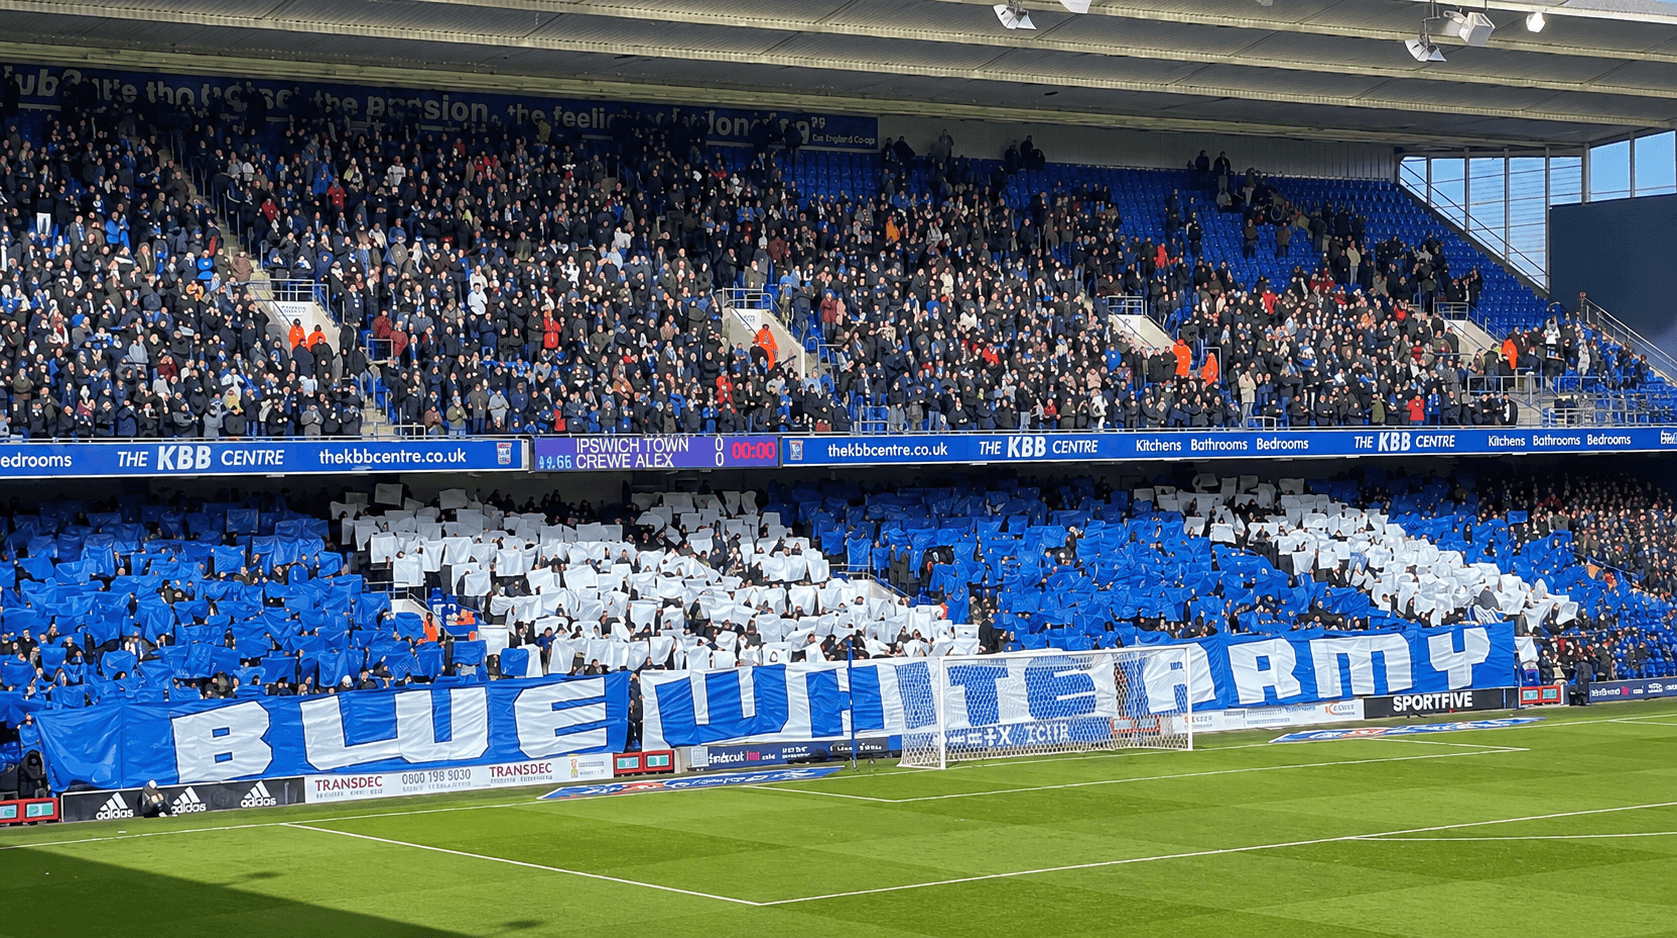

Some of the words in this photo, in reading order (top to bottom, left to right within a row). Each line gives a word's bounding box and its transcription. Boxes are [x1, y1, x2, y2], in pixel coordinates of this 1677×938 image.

[576, 438, 640, 453] IPSWICH
[643, 438, 690, 453] TOWN
[714, 437, 724, 452] 0
[979, 440, 1002, 455] THE
[1006, 435, 1047, 458] KBB
[1052, 439, 1099, 454] CENTRE
[1136, 438, 1182, 452] Kitchens
[1190, 437, 1248, 451] Bathrooms
[1256, 436, 1309, 450] Bedrooms
[1354, 436, 1374, 449] THE
[1378, 432, 1412, 452] KBB
[1415, 434, 1456, 448] CENTRE
[1488, 435, 1526, 447] Kitchens
[1532, 434, 1581, 446] Bathrooms
[1587, 433, 1632, 446] Bedrooms
[319, 448, 467, 465] thekbbcentre.co.uk
[731, 441, 776, 460] 00:00
[827, 441, 949, 457] thekbbcentre.co.uk
[0, 452, 72, 468] edrooms
[117, 451, 149, 467] THE
[157, 445, 211, 471] KBB
[221, 449, 285, 466] CENTRE
[576, 454, 631, 469] CREWE
[635, 453, 675, 469] ALEX
[714, 452, 725, 468] 0
[171, 677, 606, 783] BLUE
[655, 655, 1096, 747] WHITE
[1143, 627, 1491, 713] ARMY
[1392, 691, 1474, 712] SPORTFIVE
[428, 770, 445, 782] 198
[488, 762, 552, 778] TRANSDEC
[314, 775, 382, 792] TRANSDEC
[171, 802, 207, 814] adidas
[240, 797, 277, 808] adidas
[95, 808, 134, 821] adidas
